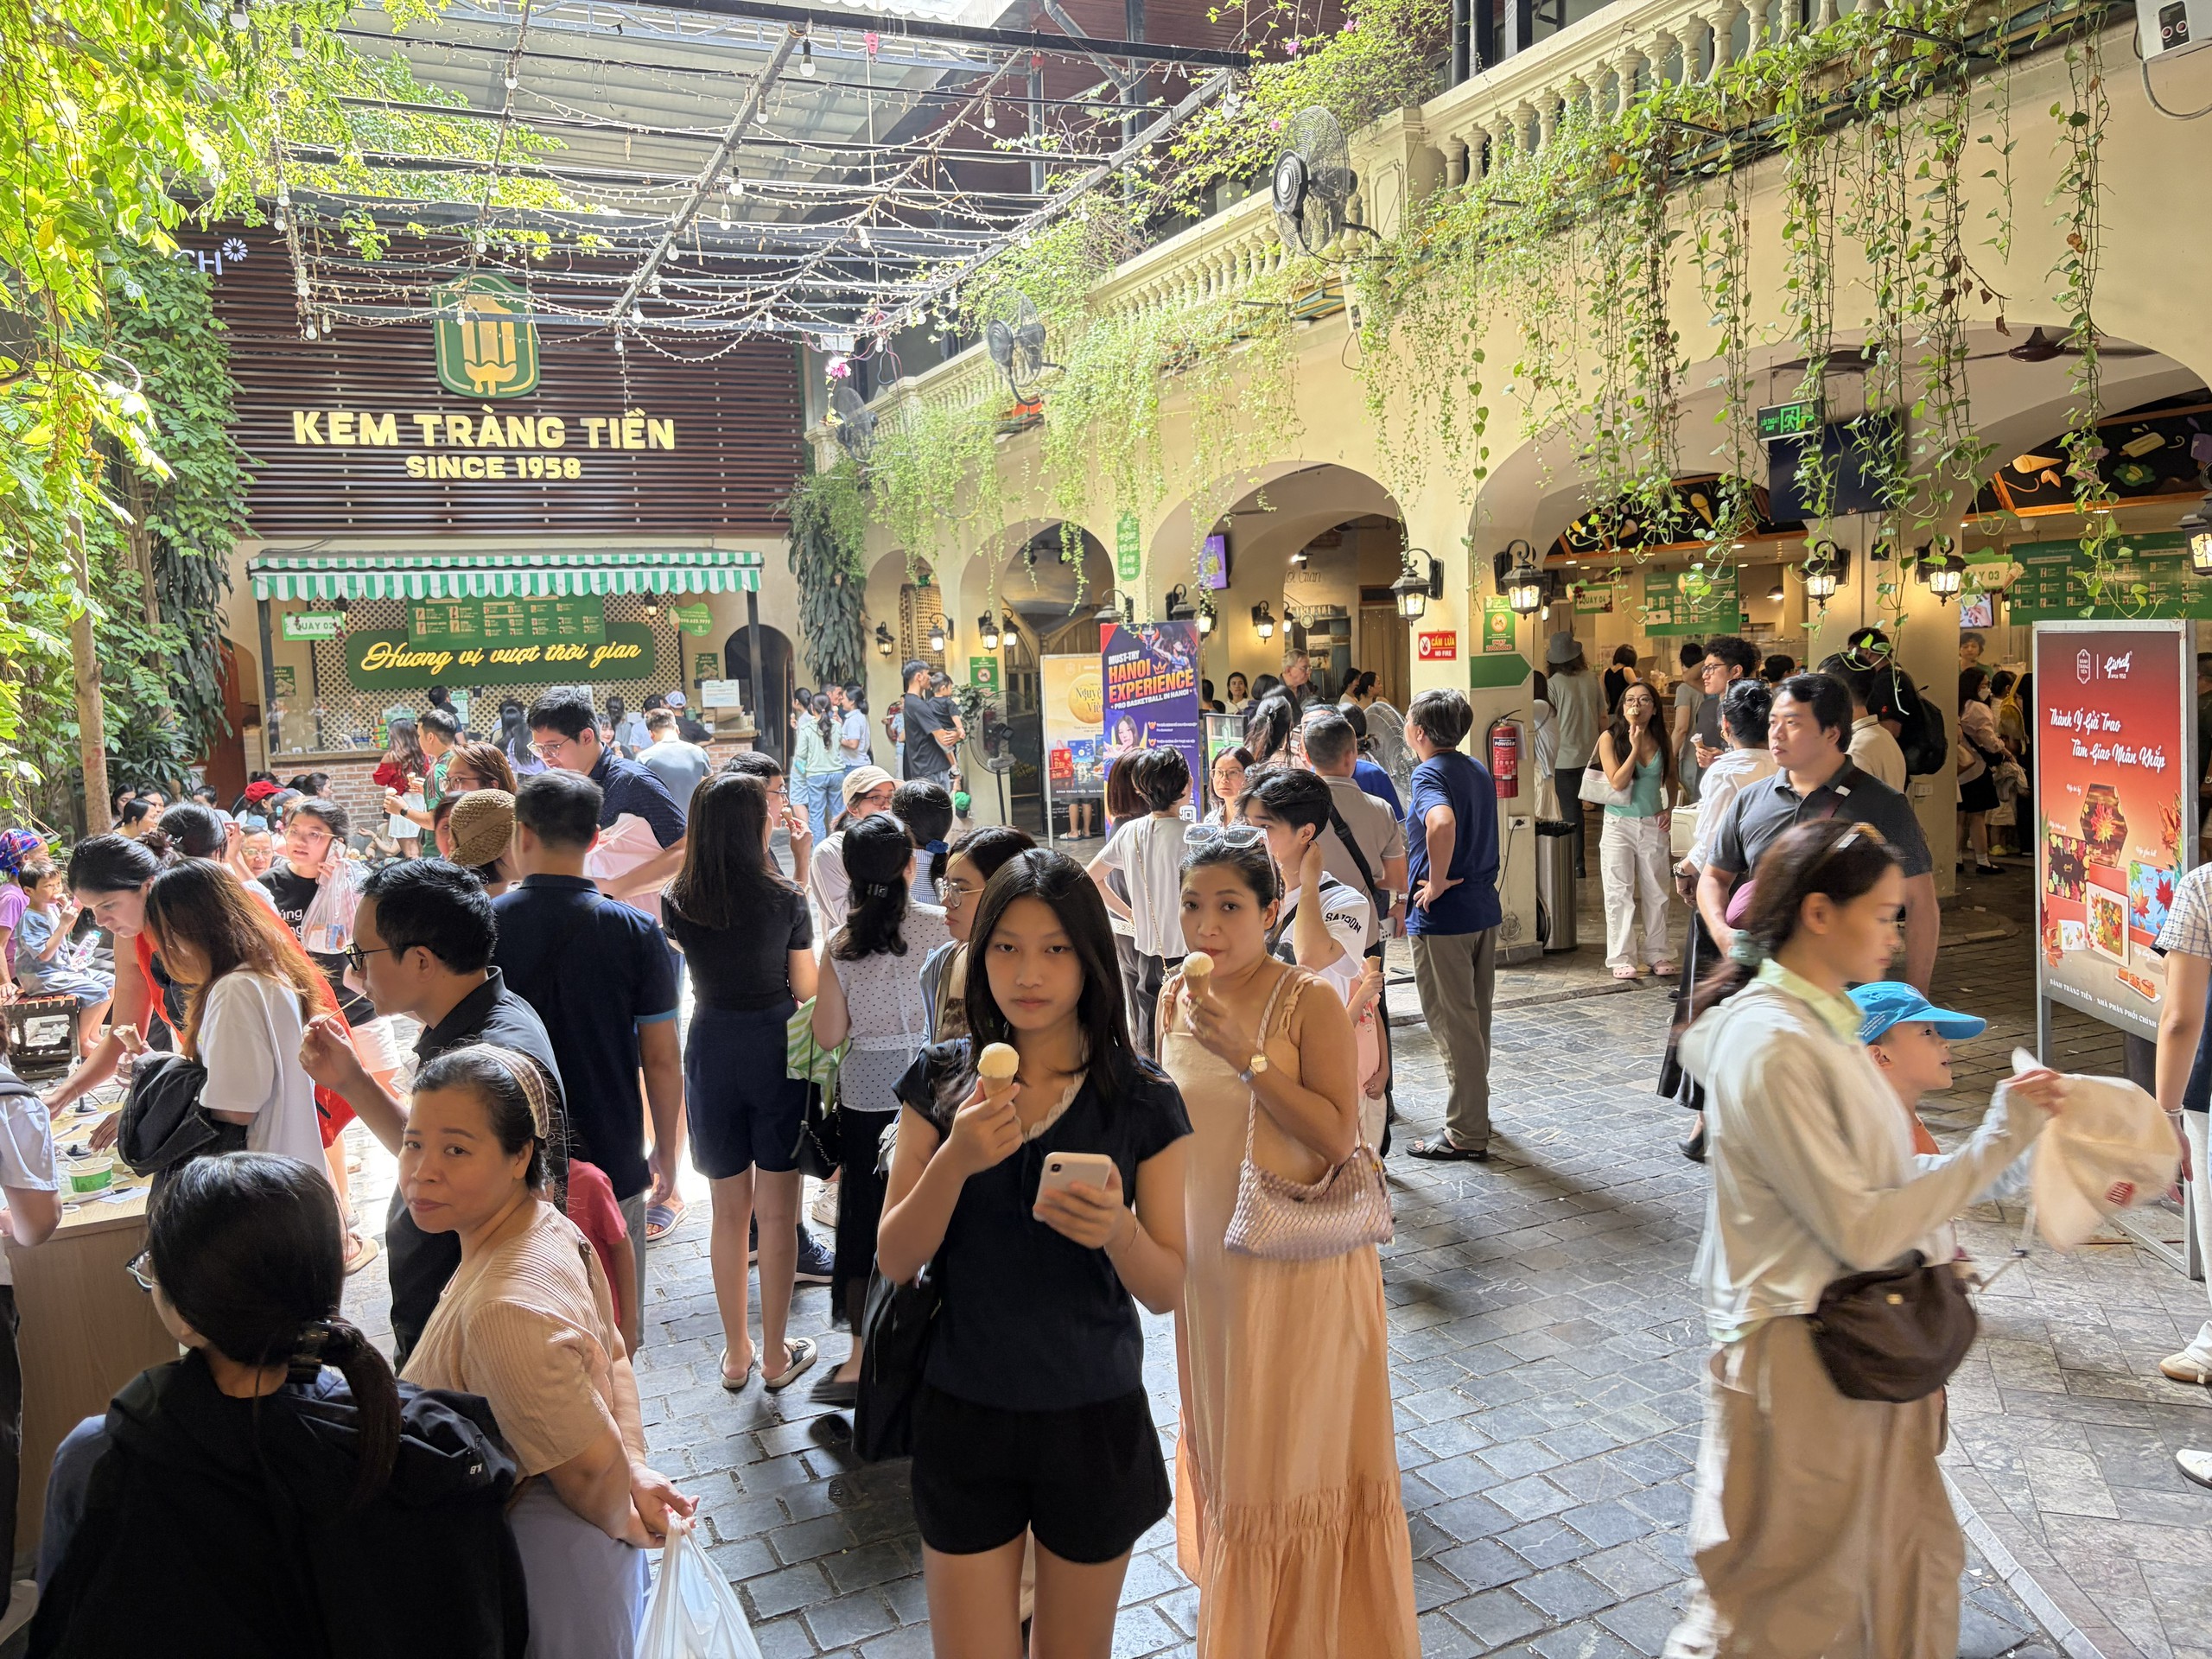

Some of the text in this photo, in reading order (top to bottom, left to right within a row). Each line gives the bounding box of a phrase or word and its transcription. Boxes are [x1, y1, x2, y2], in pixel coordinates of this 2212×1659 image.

[292, 404, 676, 450] KEM TRÀNG TIỀN
[405, 455, 582, 480] SINCE 1958
[1988, 570, 2000, 581] 03
[1431, 635, 1455, 647] CẤM LỬA
[458, 647, 485, 667] vị
[544, 643, 589, 662] thời
[588, 640, 642, 669] gian
[1109, 650, 1140, 665] MUST-TRY
[1109, 658, 1151, 683] HANOI
[1076, 688, 1102, 703] Nguyệ
[1109, 669, 1194, 703] EXPERIENCE
[1127, 695, 1163, 707] BASKETBALL
[1171, 689, 1189, 698] HANOI
[2050, 707, 2073, 728] Thành
[2074, 706, 2083, 733] Ý
[2101, 712, 2122, 733] Trao
[2071, 738, 2088, 758] Tâm
[2089, 743, 2111, 766] Giao
[2139, 745, 2166, 774] Khắp
[2063, 983, 2080, 995] TRÀNG
[2096, 997, 2108, 1008] NHÀ
[2124, 1009, 2139, 1020] PHỐI
[2139, 1015, 2158, 1028] CHÍNH
